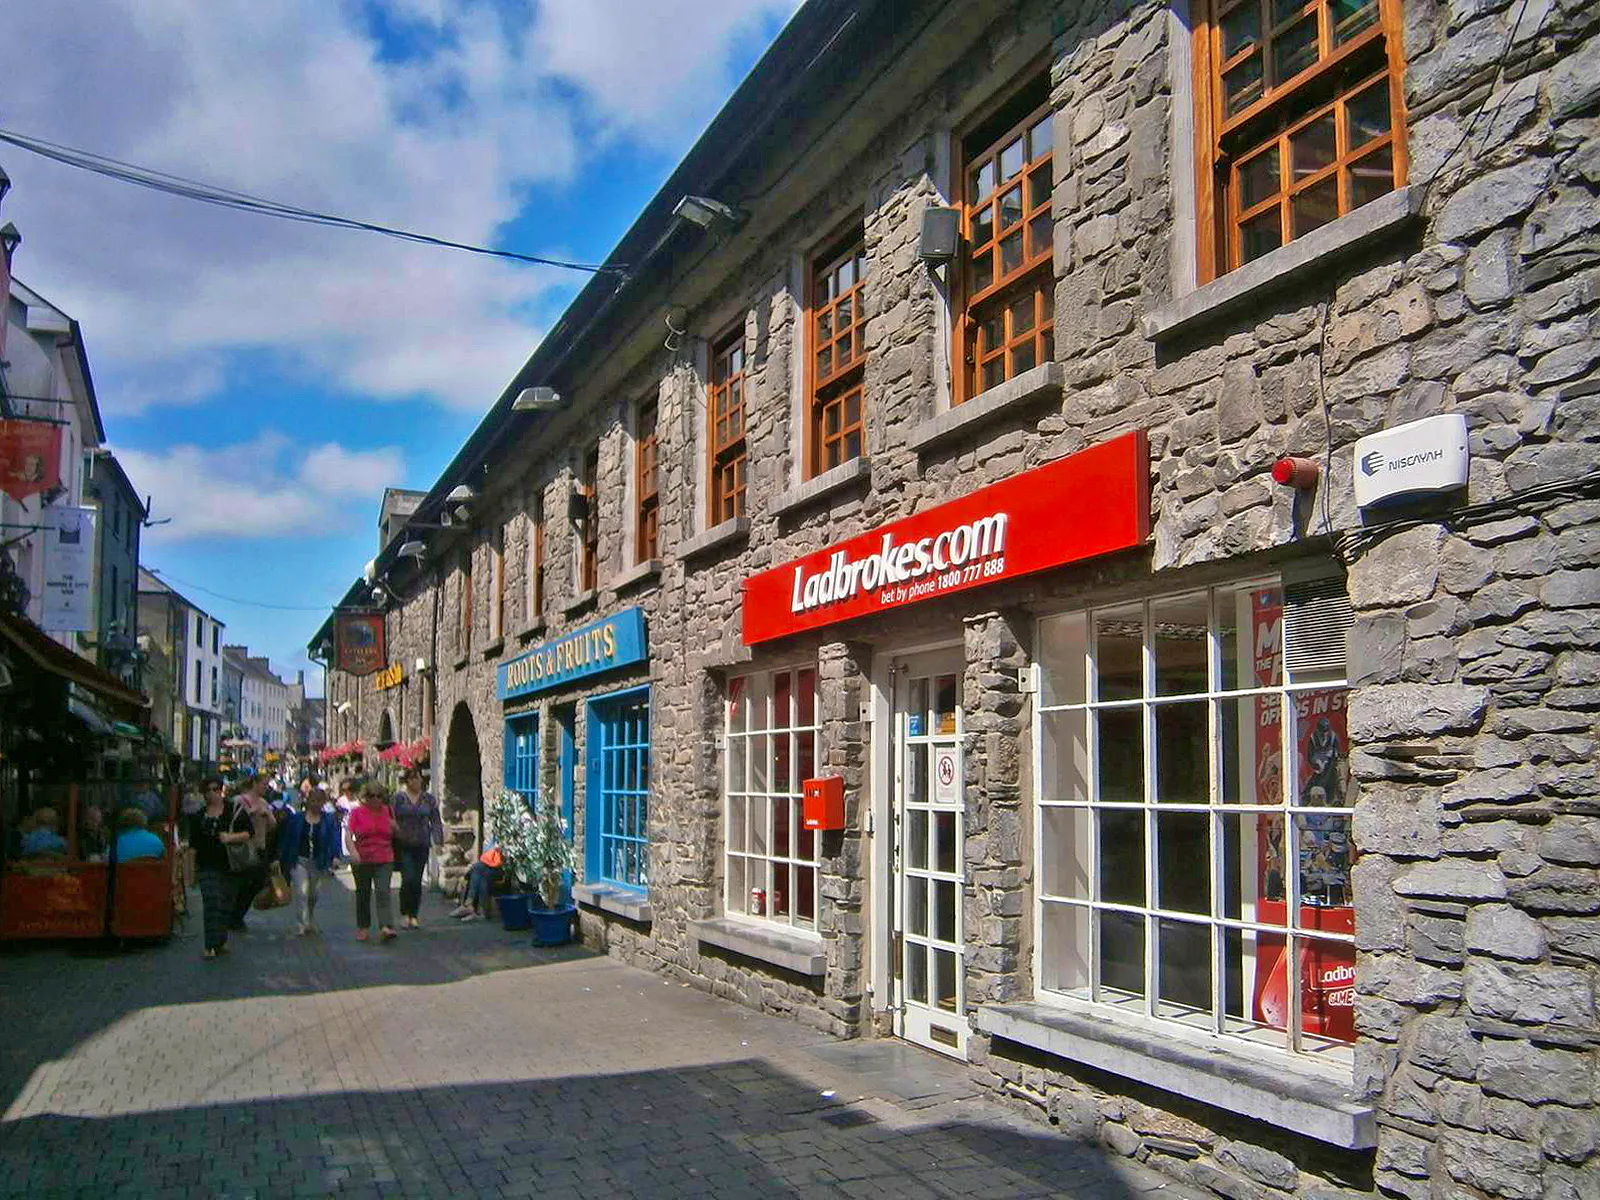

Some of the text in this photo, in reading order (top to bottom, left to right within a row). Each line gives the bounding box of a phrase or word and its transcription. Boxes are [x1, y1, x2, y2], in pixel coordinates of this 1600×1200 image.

[1388, 449, 1443, 471] NISCAYAH
[791, 512, 1007, 612] Ladbrokes.com
[881, 556, 1004, 604] bet by phone 1800 777 888
[507, 623, 615, 690] ROOTS & FRUITS
